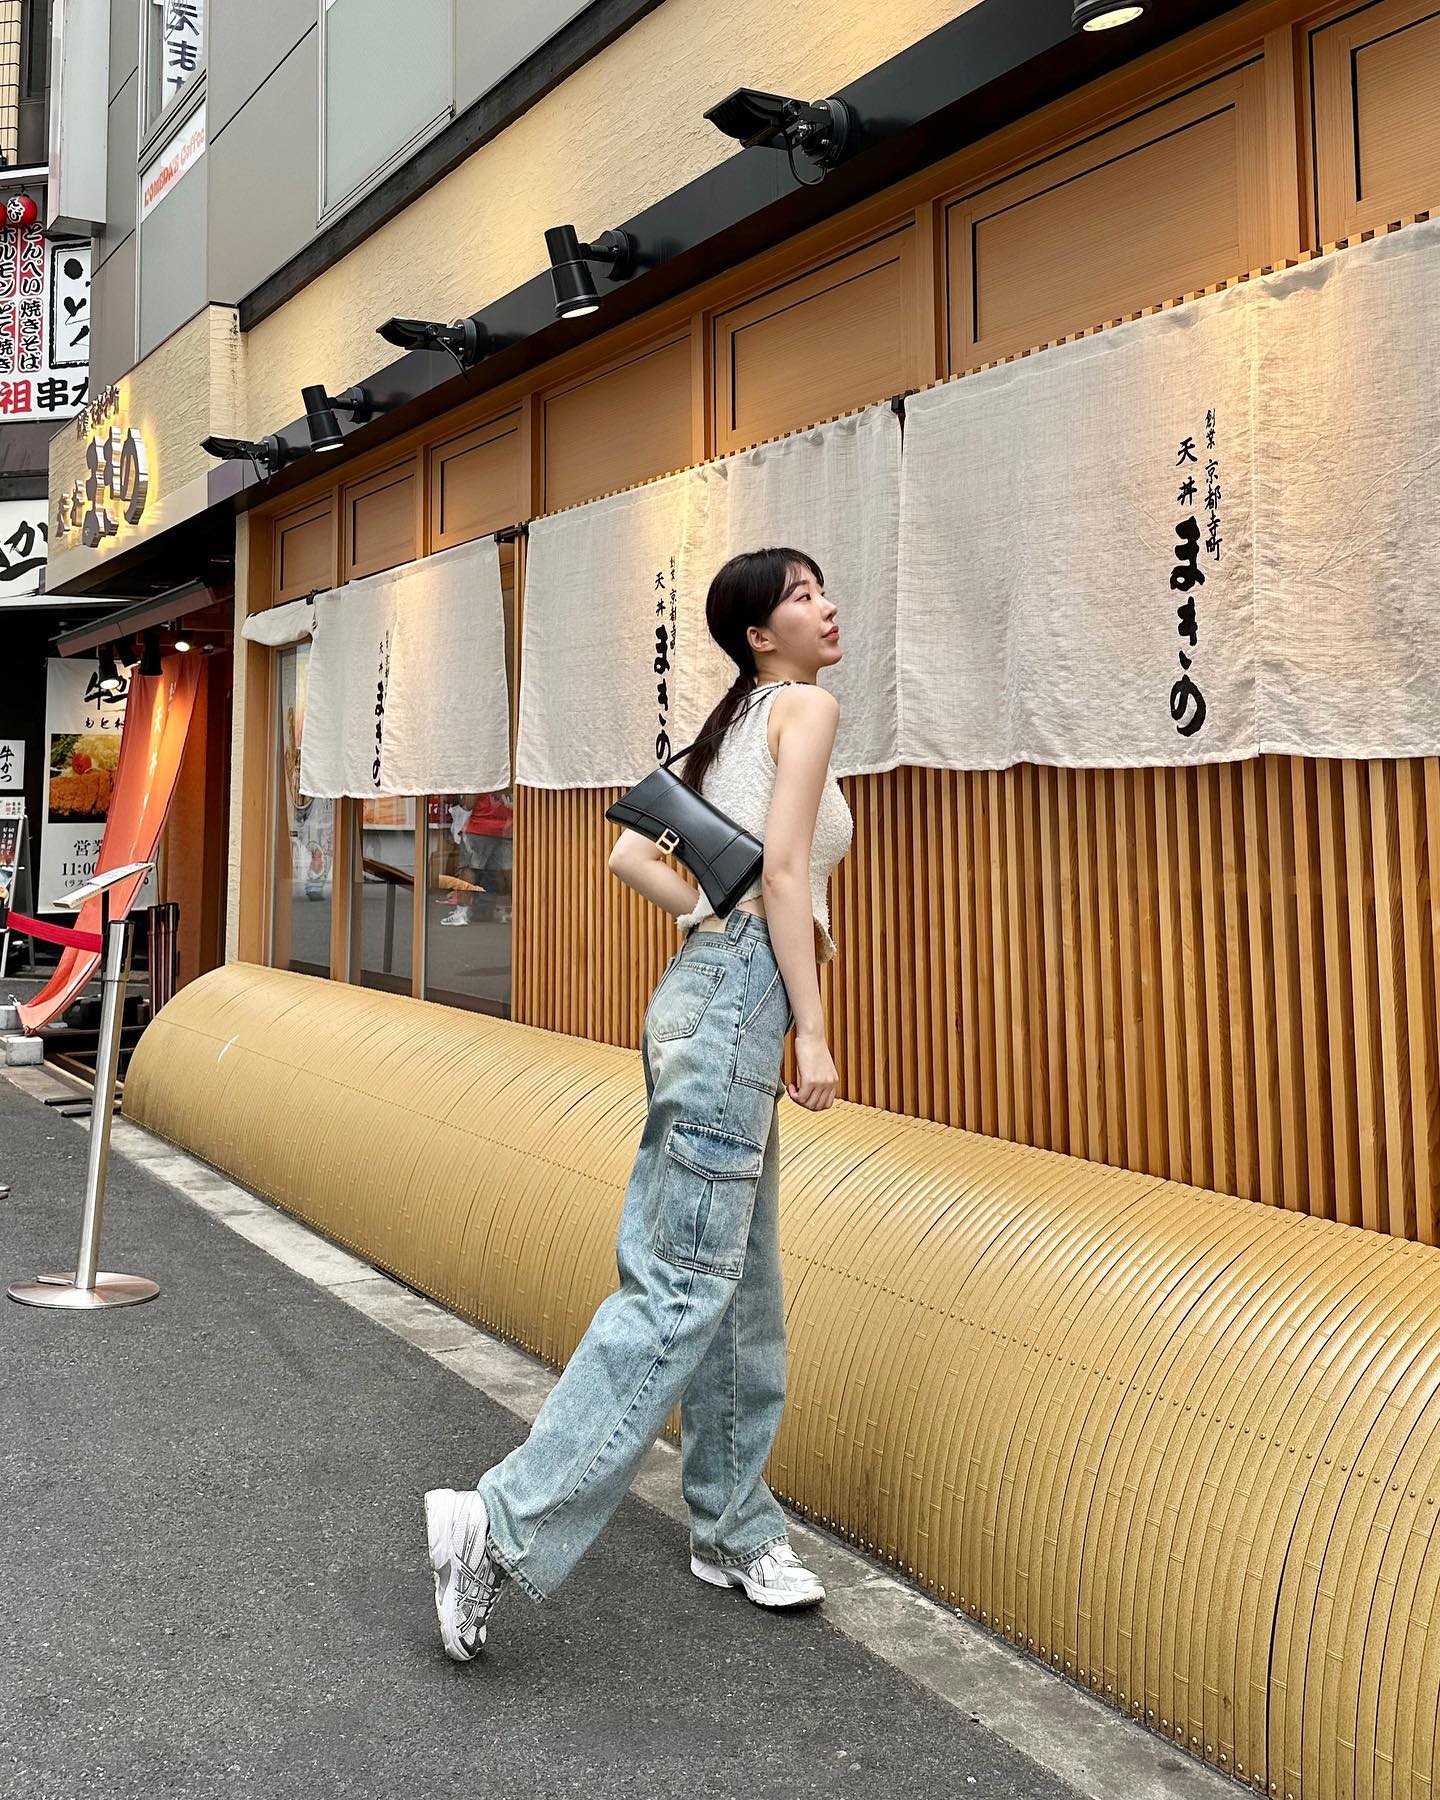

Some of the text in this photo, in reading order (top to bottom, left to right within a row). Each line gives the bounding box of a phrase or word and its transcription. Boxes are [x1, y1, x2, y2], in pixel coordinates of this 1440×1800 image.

[22, 224, 43, 294] とんぺい
[20, 300, 42, 370] 焼きそば
[0, 745, 15, 783] 牛かつ
